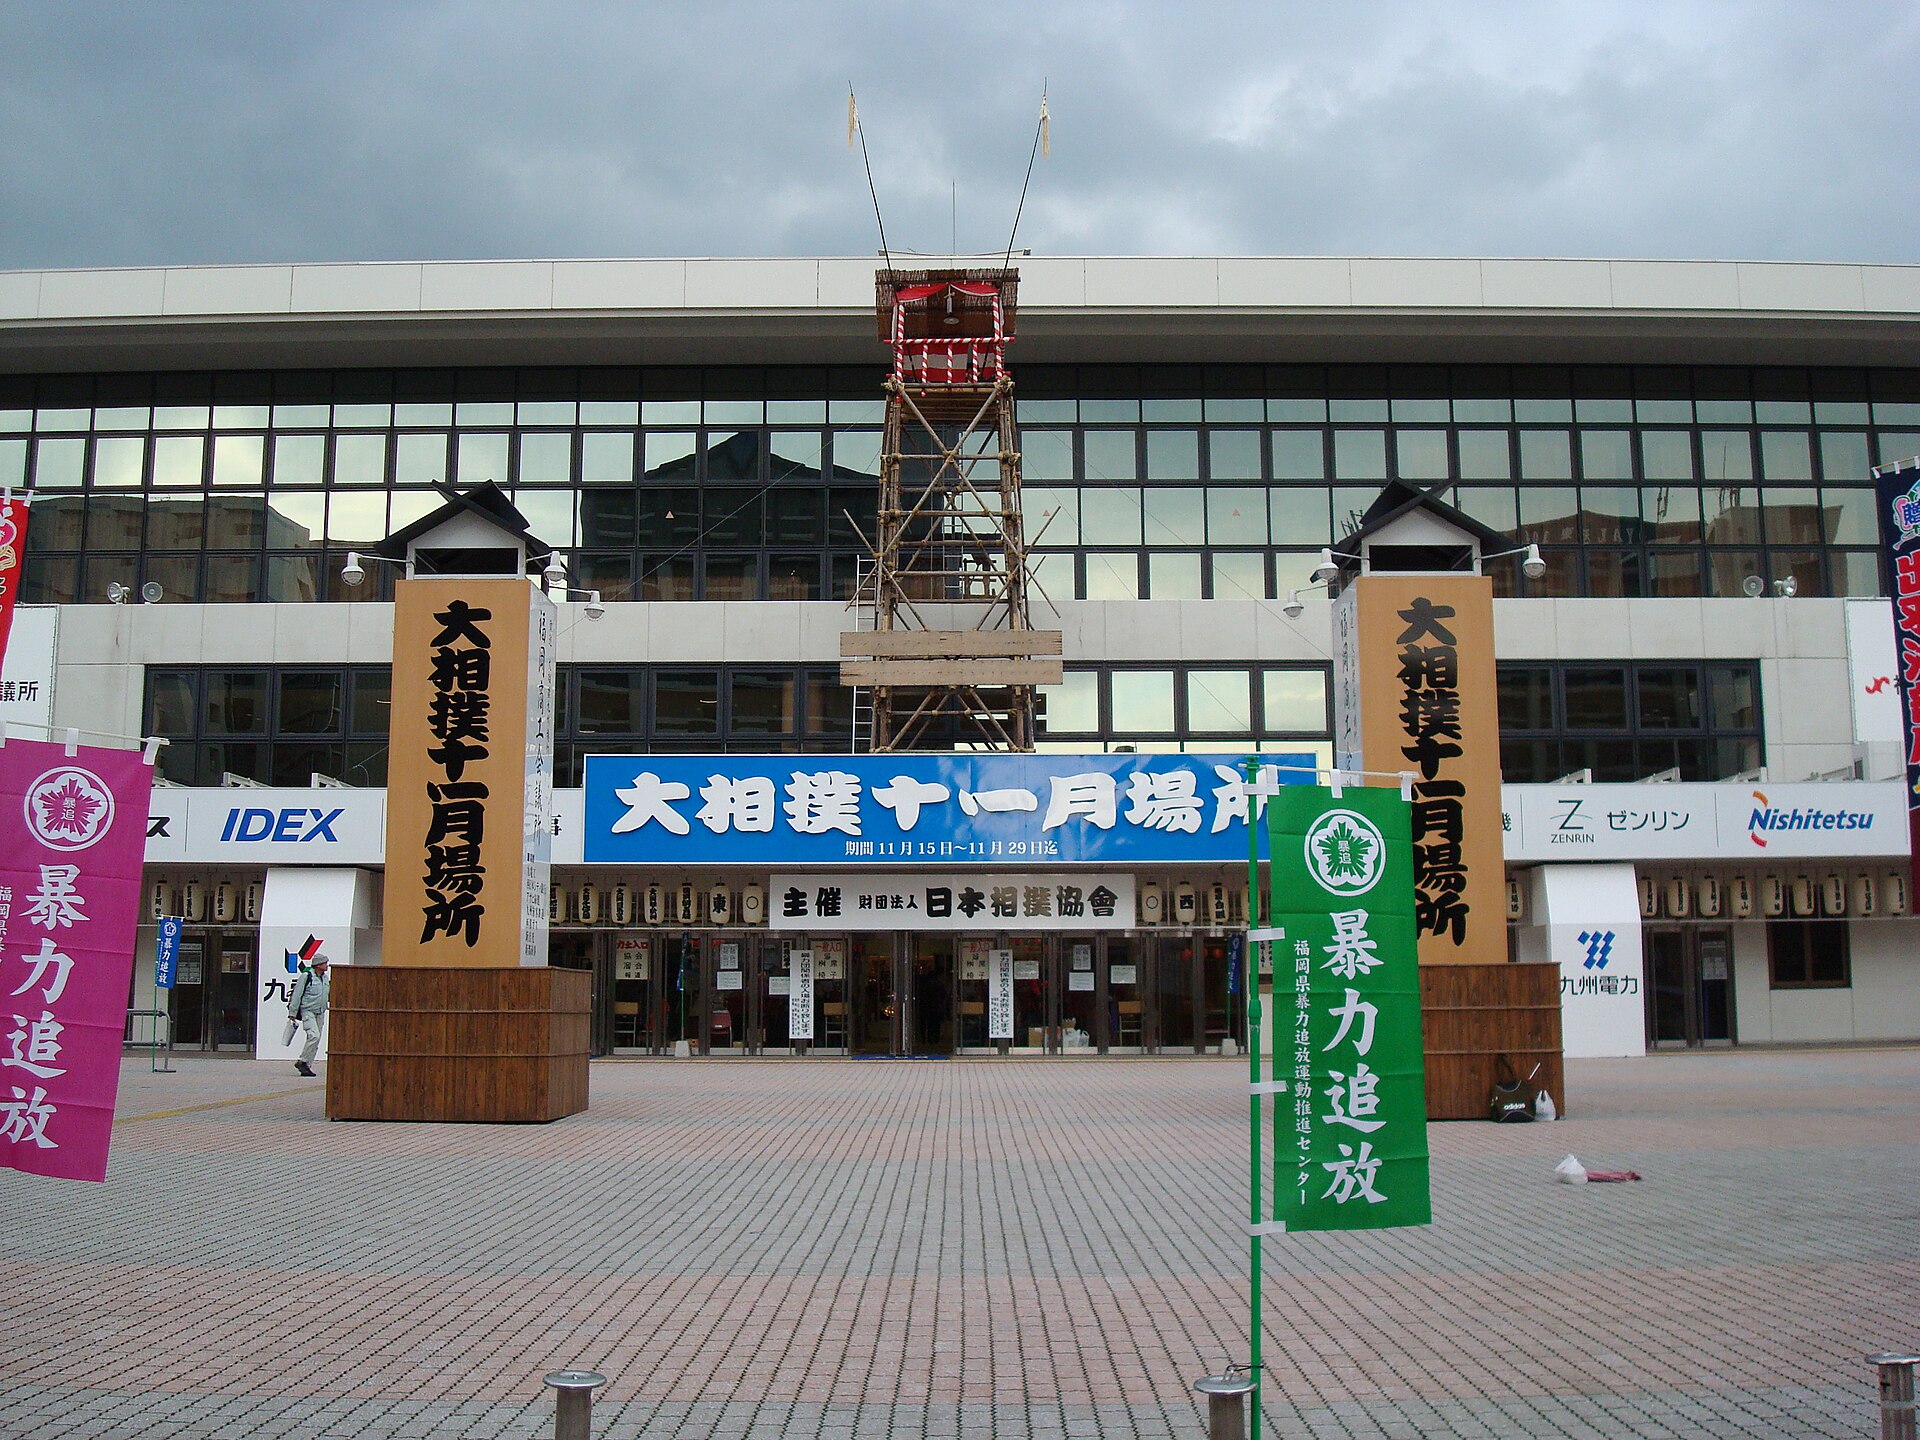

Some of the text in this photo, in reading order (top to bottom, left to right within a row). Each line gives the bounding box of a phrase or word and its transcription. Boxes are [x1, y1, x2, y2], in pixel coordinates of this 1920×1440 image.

[420, 600, 493, 948] 大相撲十一月場所
[220, 808, 346, 843] IDEX
[1606, 809, 1690, 832] ゼンリン
[1748, 808, 1874, 831] Nishitetsu
[1551, 833, 1595, 844] ZENRIN
[712, 893, 727, 912] 東
[783, 886, 842, 918] 主催
[858, 894, 919, 911] 財団法人
[1179, 895, 1196, 910] 西
[157, 937, 173, 984] 暴力追放
[1561, 975, 1639, 995] 九州電力
[0, 863, 91, 1149] 暴力追放
[1293, 939, 1312, 1206] 福岡県暴力追放運動推進センター
[1319, 908, 1388, 1205] 暴力追放
